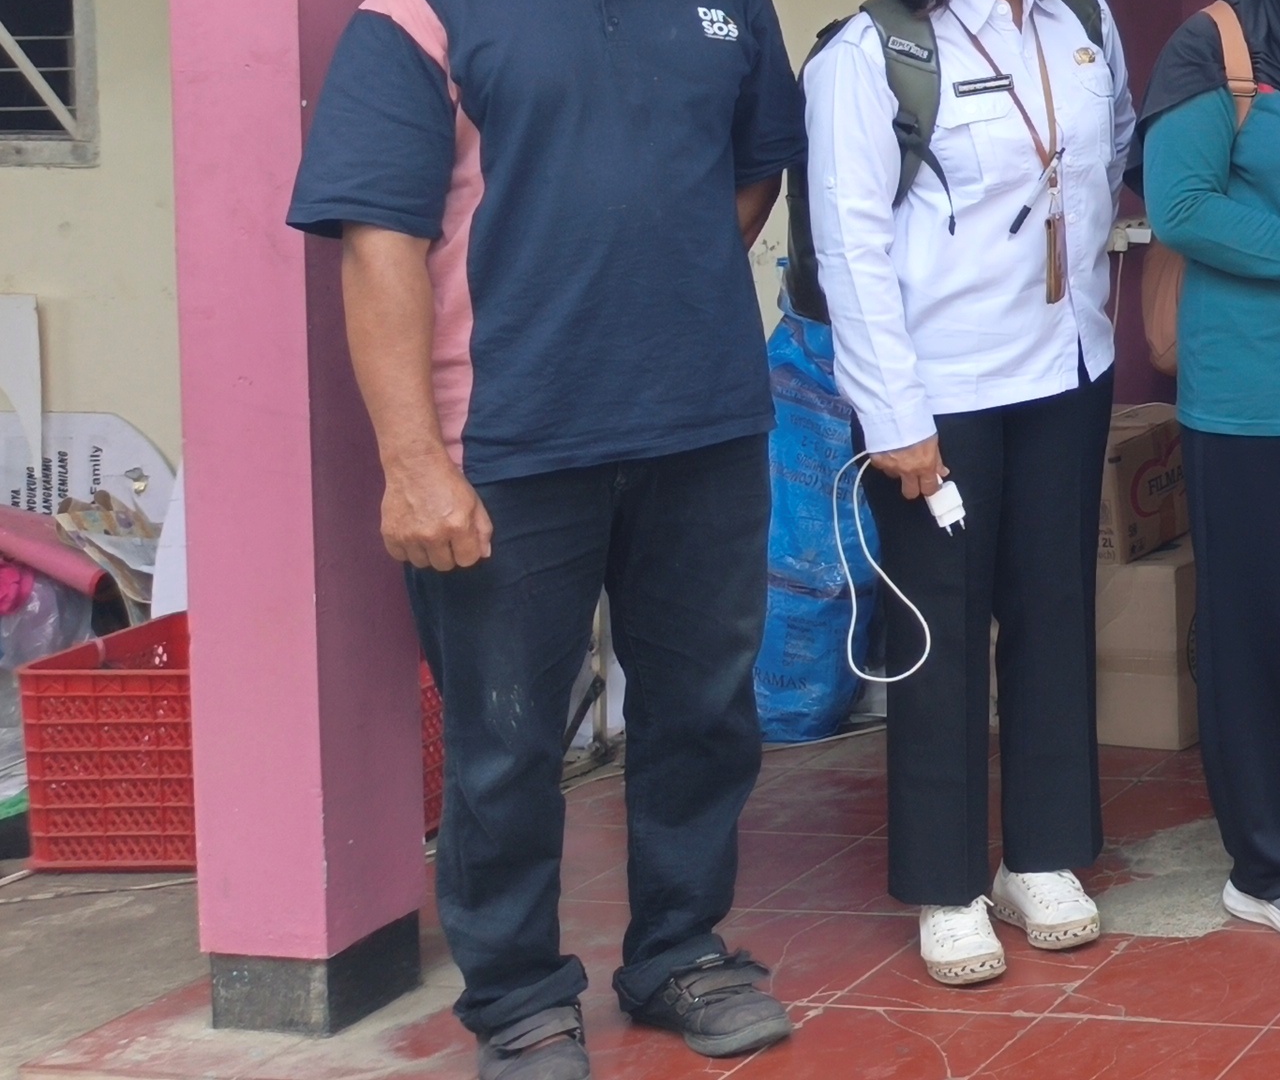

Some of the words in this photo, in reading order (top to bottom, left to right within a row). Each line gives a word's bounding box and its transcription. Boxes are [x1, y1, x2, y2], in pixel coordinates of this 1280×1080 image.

[702, 21, 739, 38] SOS
[58, 450, 68, 499] GEMILANG
[1147, 465, 1185, 496] FILMA
